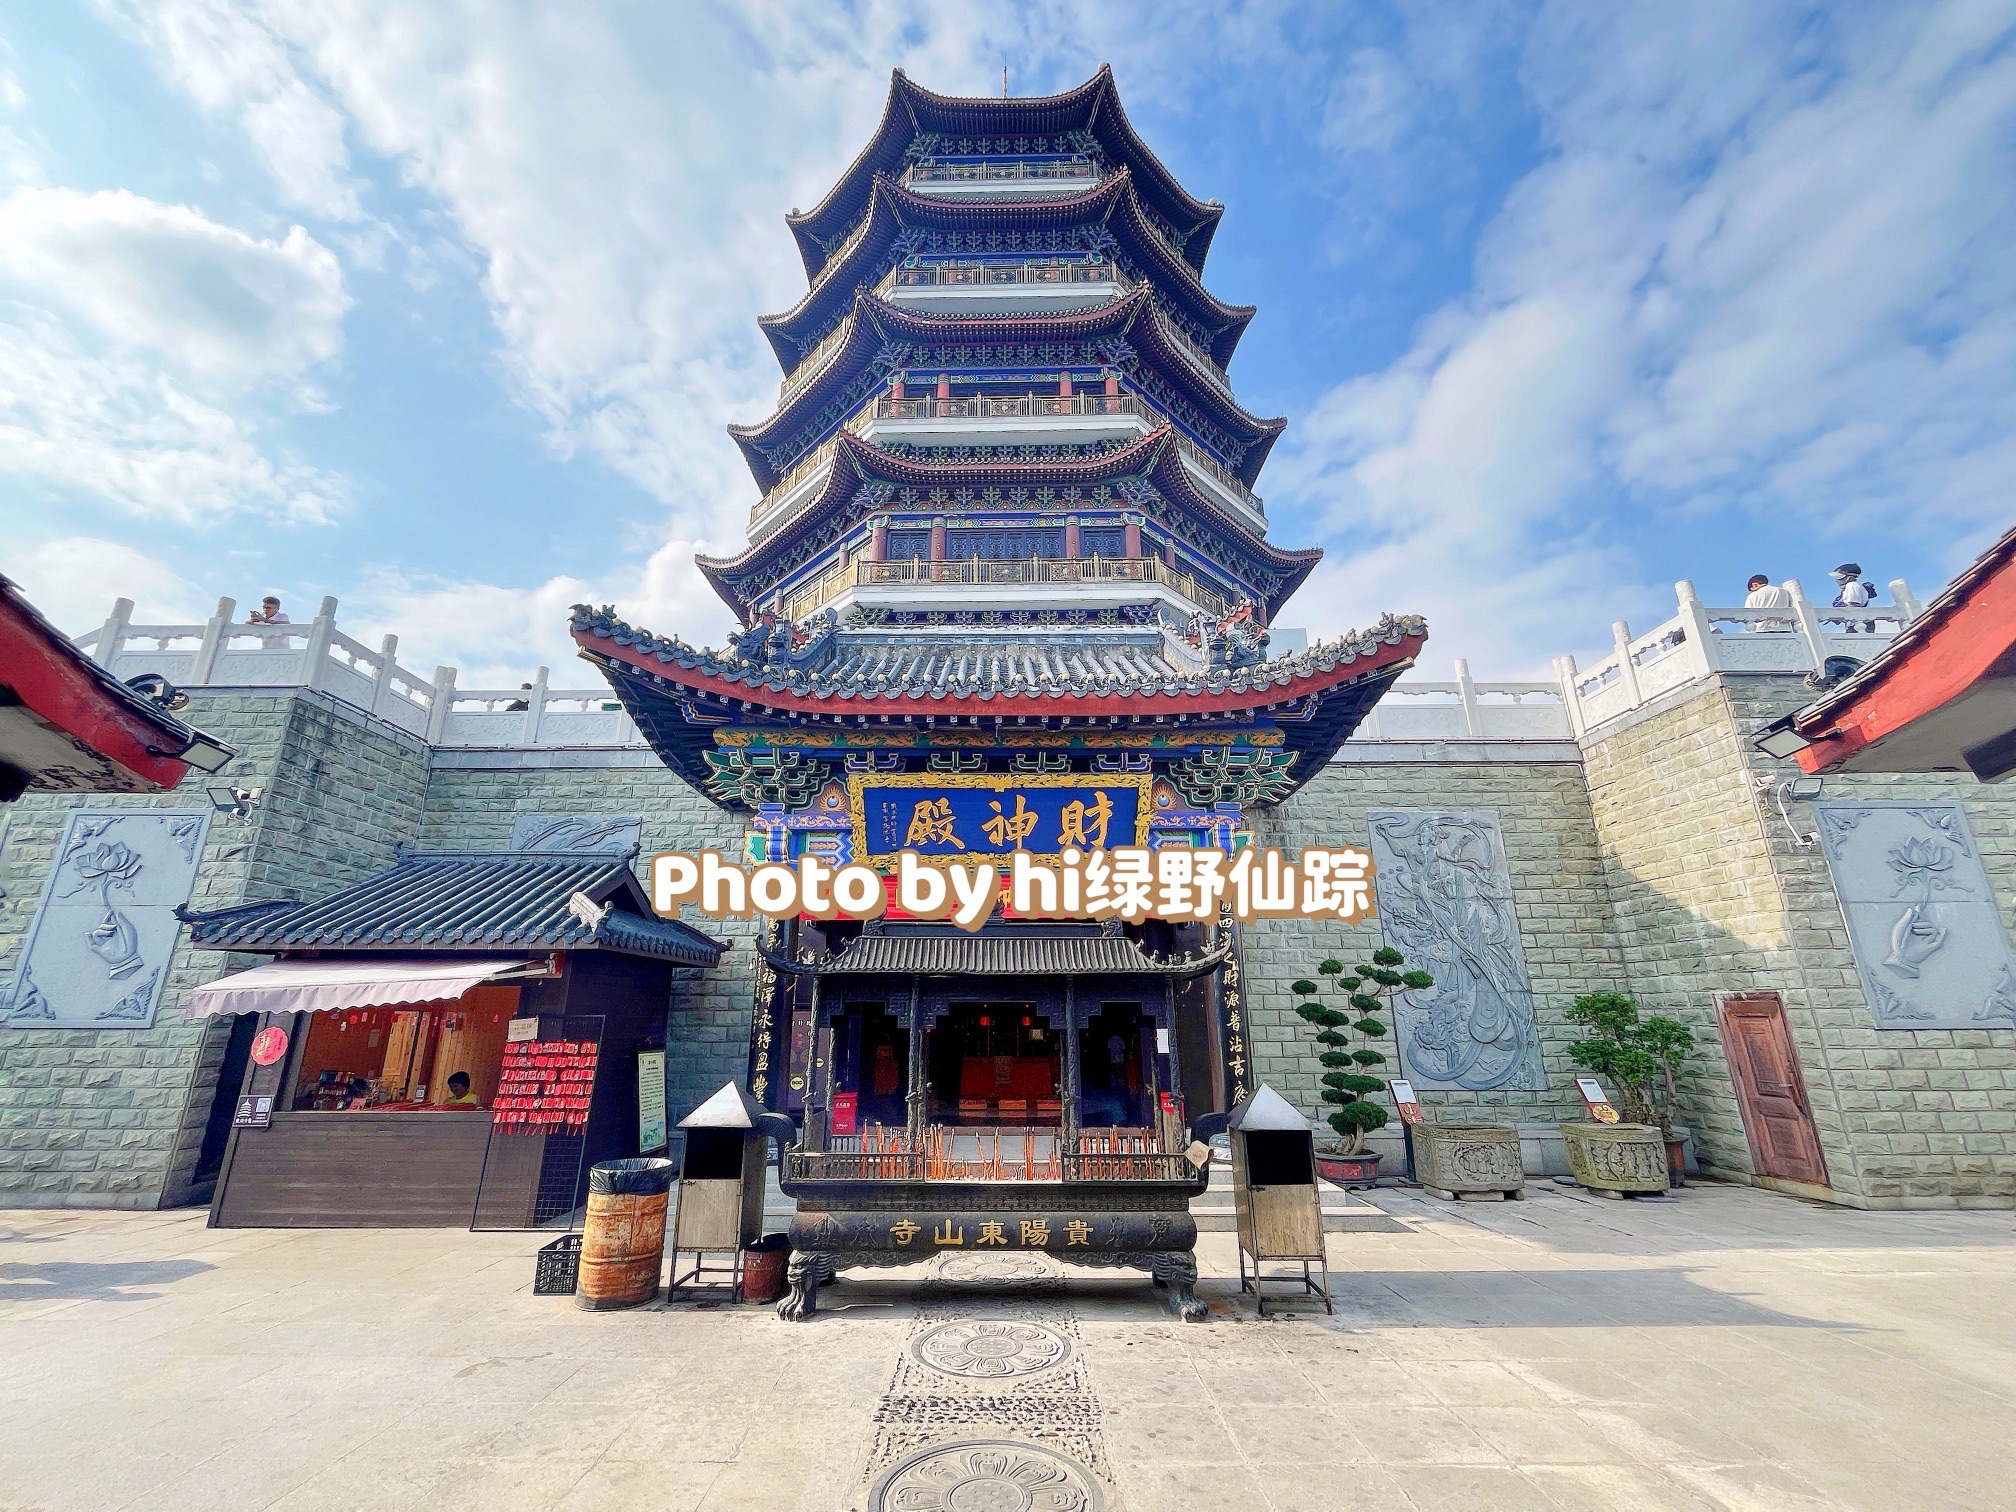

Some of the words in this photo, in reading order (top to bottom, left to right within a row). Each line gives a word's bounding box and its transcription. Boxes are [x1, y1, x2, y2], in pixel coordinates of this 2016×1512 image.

[903, 790, 1114, 849] 財神殿
[889, 1218, 1094, 1246] 貴陽東山寺
